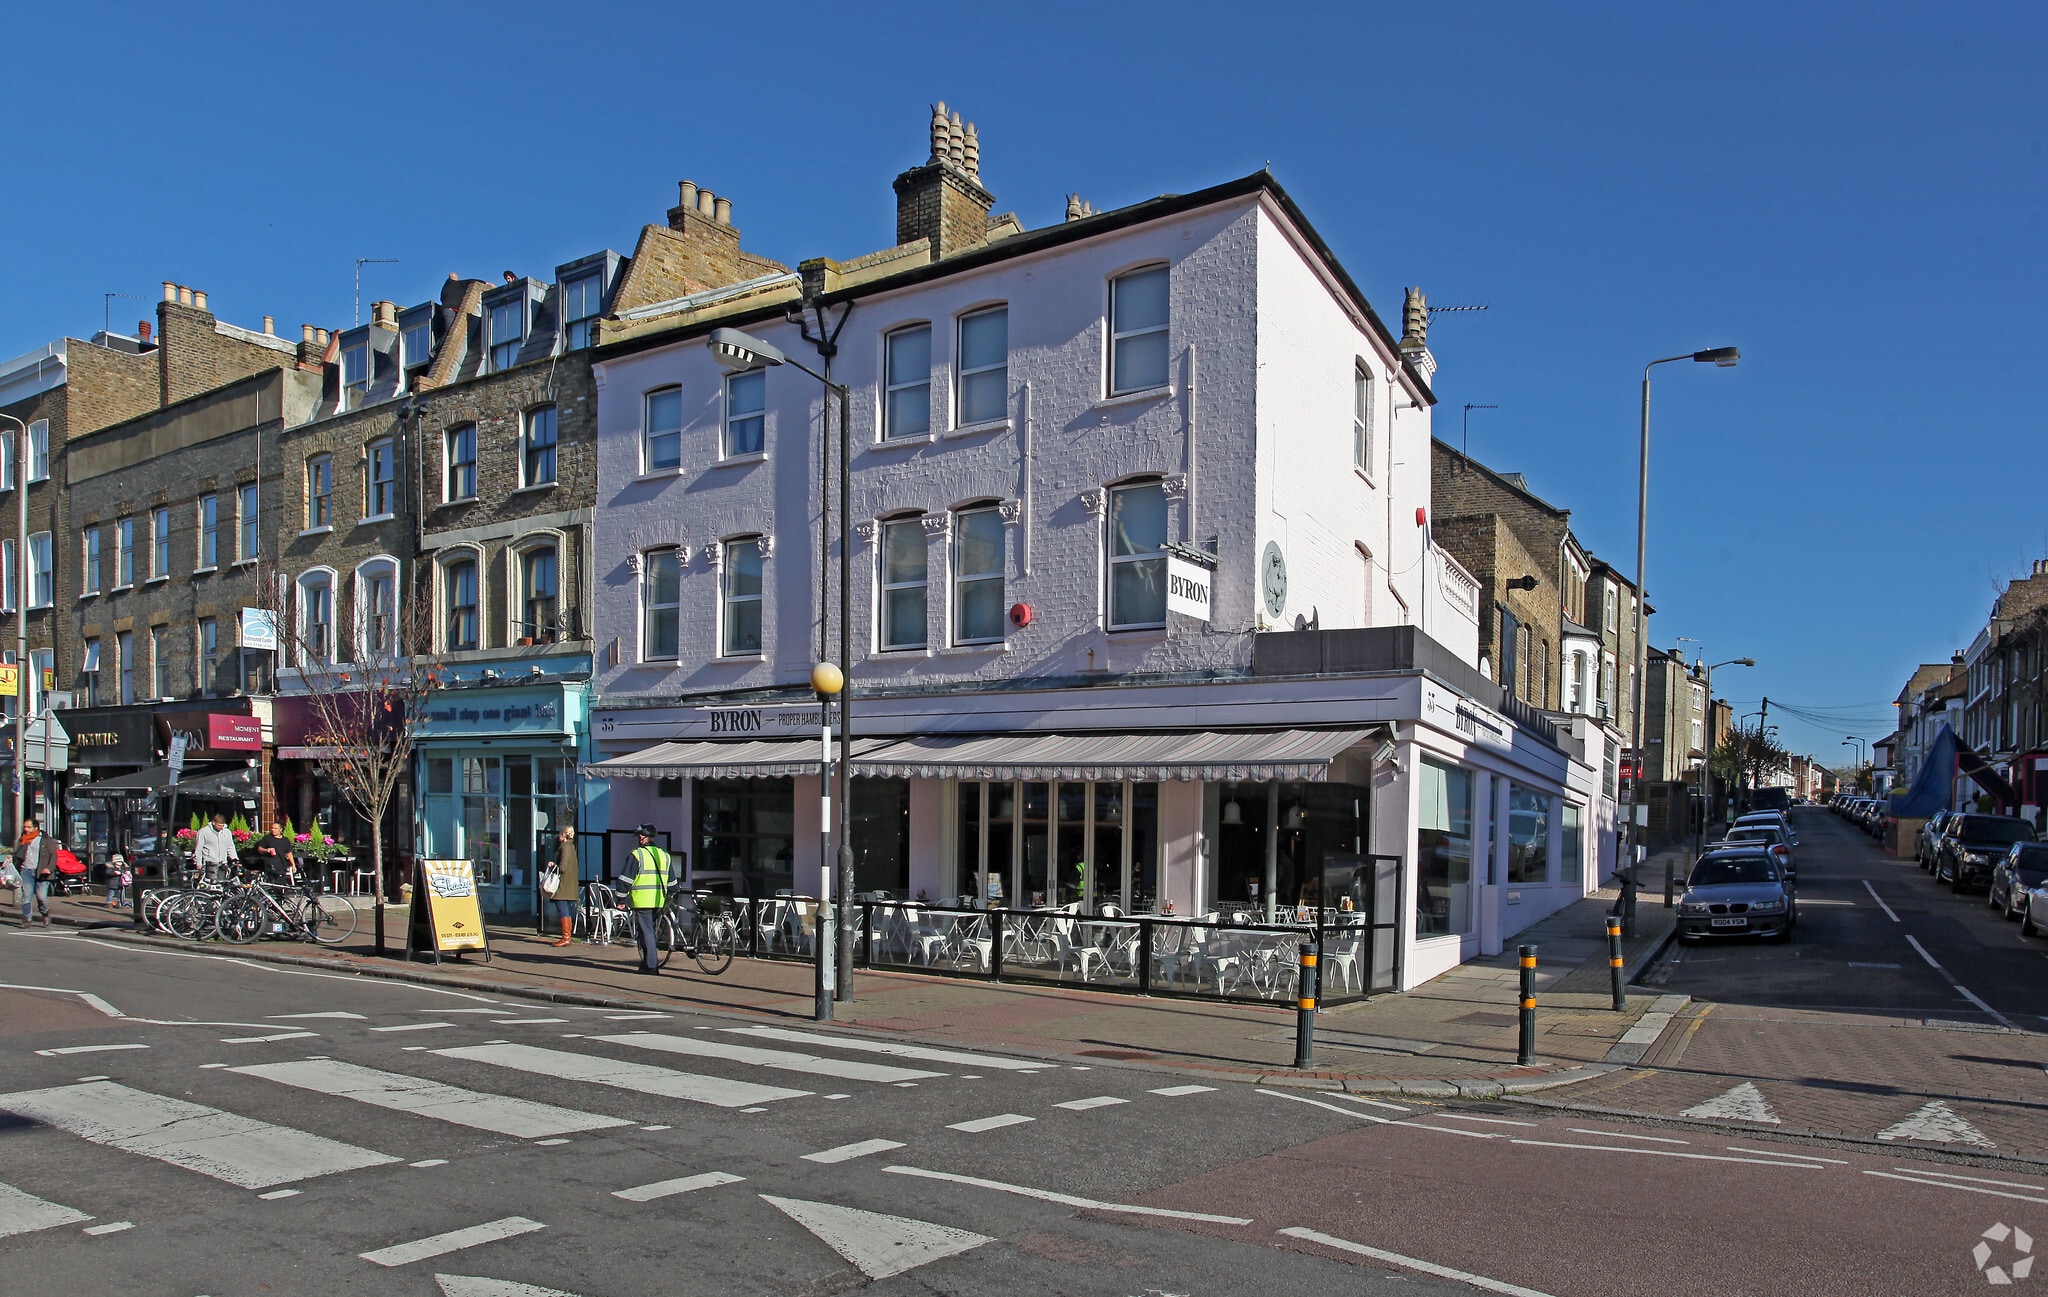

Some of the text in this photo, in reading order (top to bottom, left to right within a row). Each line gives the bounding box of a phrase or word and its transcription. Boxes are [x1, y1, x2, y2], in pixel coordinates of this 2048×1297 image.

[1170, 574, 1208, 604] BYRON
[431, 707, 456, 721] small
[459, 708, 480, 723] step
[482, 709, 501, 719] one
[503, 705, 532, 722] giant
[710, 710, 762, 732] BYRON
[778, 712, 801, 726] PROPER
[801, 711, 841, 726] HAMBUERS
[1455, 703, 1476, 736] BYRON
